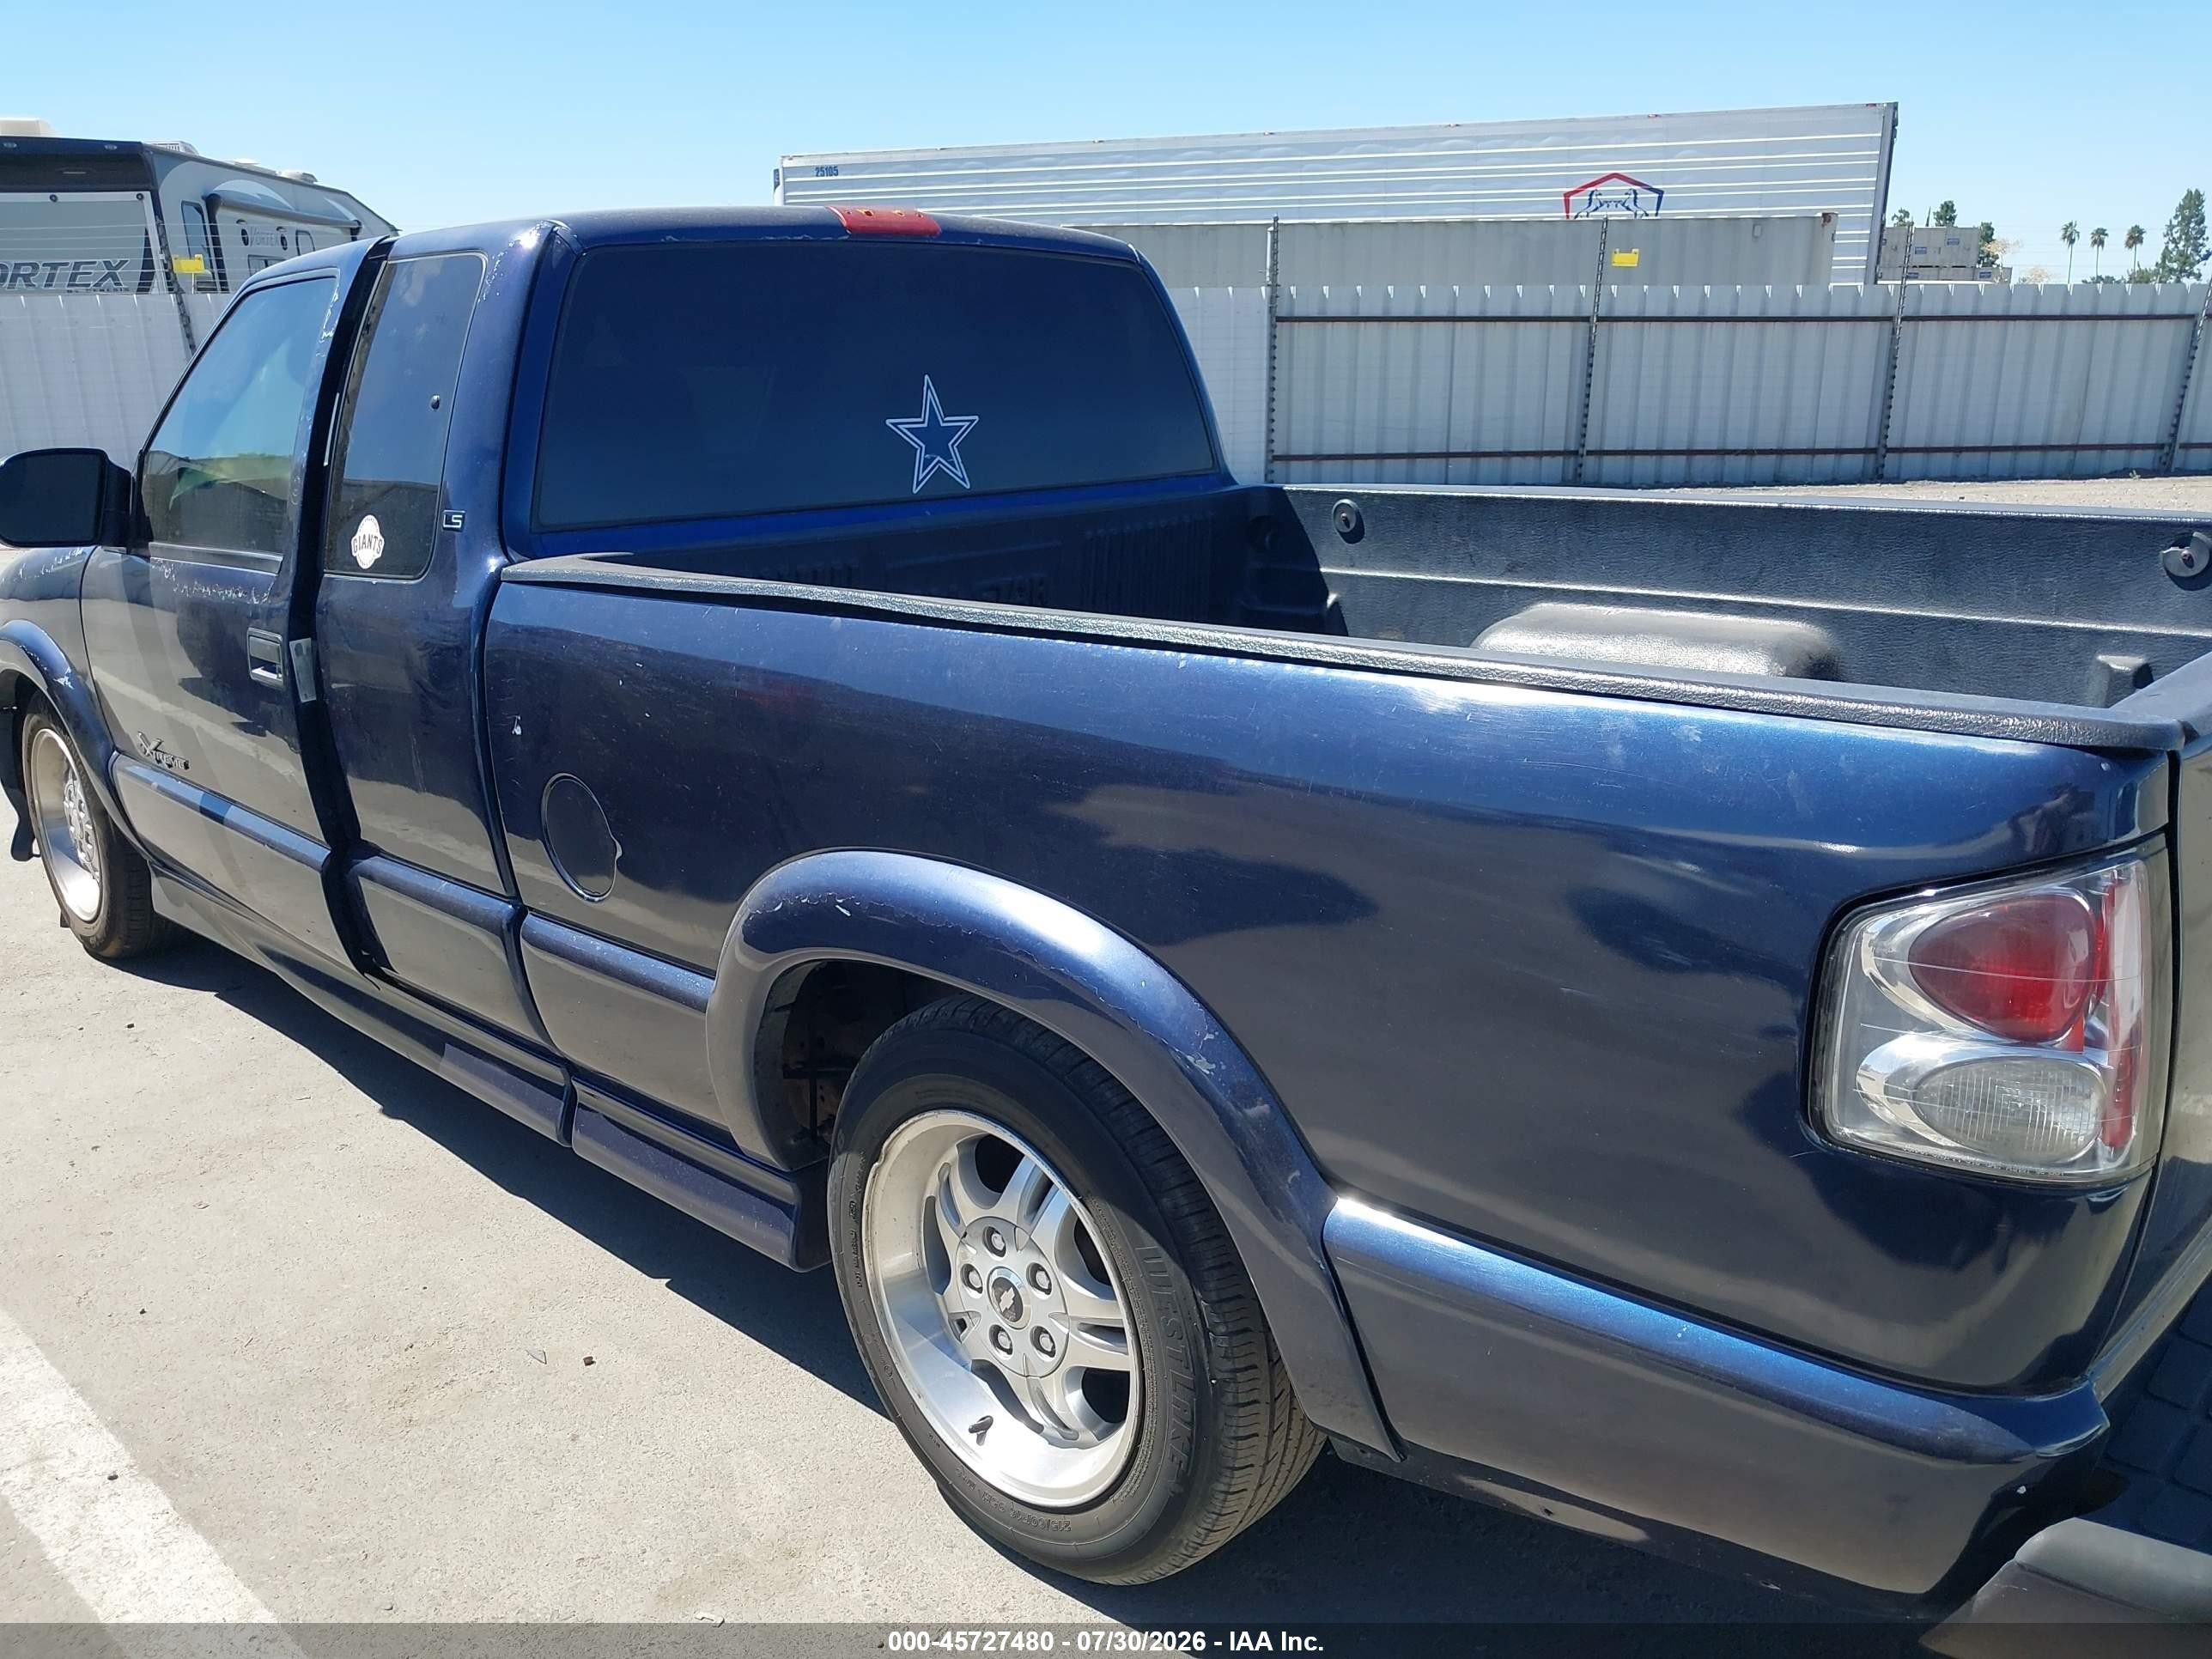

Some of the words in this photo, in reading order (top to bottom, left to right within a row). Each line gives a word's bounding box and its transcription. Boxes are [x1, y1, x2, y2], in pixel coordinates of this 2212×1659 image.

[815, 165, 838, 177] 25105
[443, 514, 463, 528] LS
[353, 533, 383, 555] GIANTS
[1134, 1245, 1195, 1477] WESTLAKE
